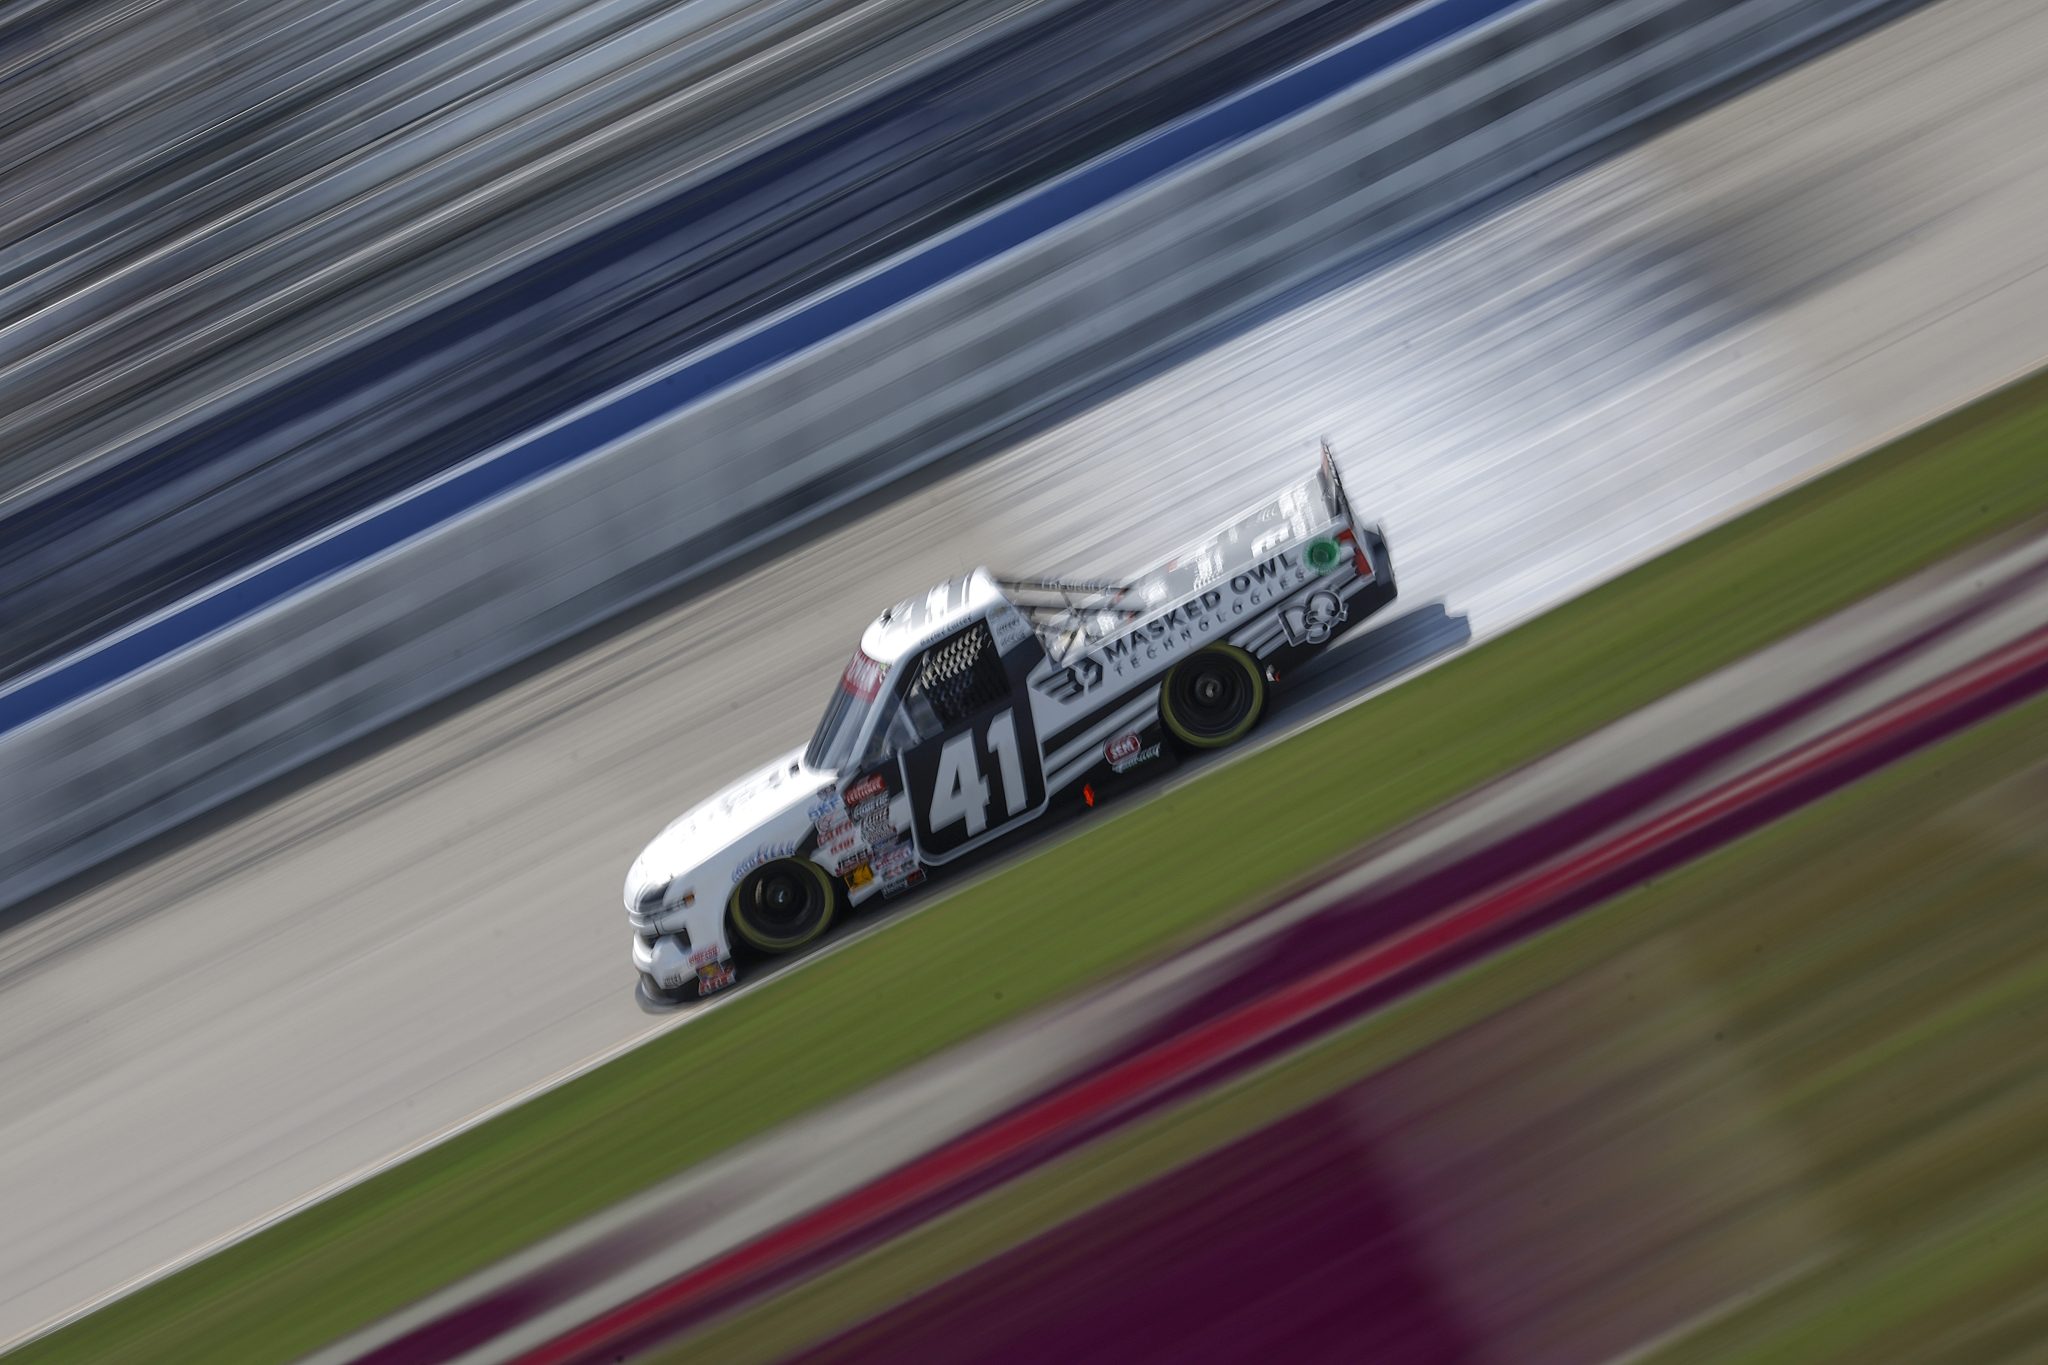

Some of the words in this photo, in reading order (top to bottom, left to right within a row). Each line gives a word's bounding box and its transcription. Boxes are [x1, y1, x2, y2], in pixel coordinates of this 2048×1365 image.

[1103, 589, 1222, 667] MASKED
[1229, 551, 1299, 595] OWL
[1112, 570, 1306, 677] TECHNOLOGIES
[928, 706, 1028, 838] 41
[1111, 736, 1136, 760] SEM
